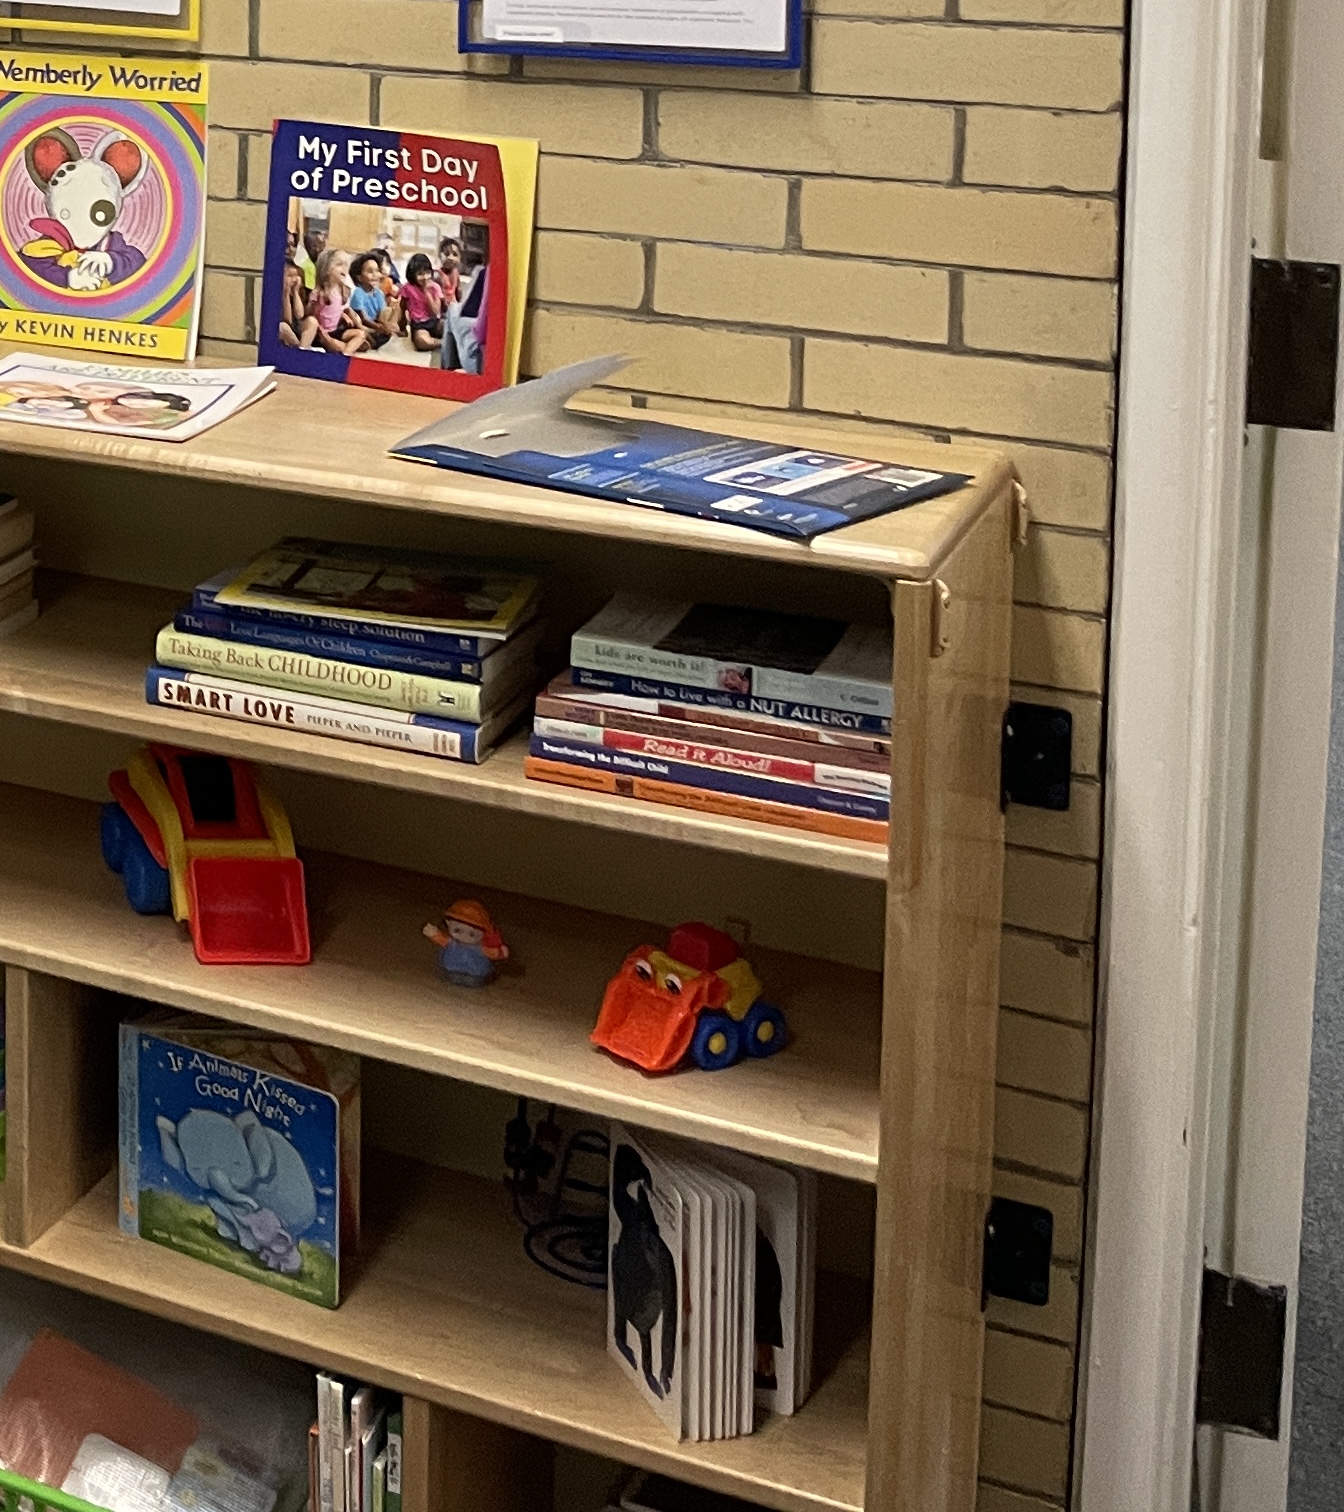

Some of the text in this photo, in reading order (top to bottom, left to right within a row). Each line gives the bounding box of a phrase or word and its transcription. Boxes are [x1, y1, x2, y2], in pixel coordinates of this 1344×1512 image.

[109, 65, 202, 94] Worried
[298, 135, 479, 183] My First Day
[290, 167, 488, 210] of Preschool
[15, 319, 75, 340] KEVIN
[83, 326, 159, 348] HENKES
[168, 637, 392, 690] Taking Back CHILDHOOD
[595, 644, 620, 658] kids
[625, 652, 645, 663] are
[649, 656, 687, 670] worth
[164, 682, 233, 712] SMART
[243, 697, 295, 724] LOVE
[306, 714, 343, 730] PIEPER
[345, 722, 371, 734] AND
[375, 727, 414, 743] PIEPER
[631, 679, 660, 695] How
[663, 685, 677, 698] to
[679, 687, 703, 702] Live
[736, 699, 745, 709] a
[750, 697, 787, 717] NUT
[790, 705, 863, 729] ALLERGY
[644, 739, 688, 759] Read
[709, 751, 772, 774] Aloud!
